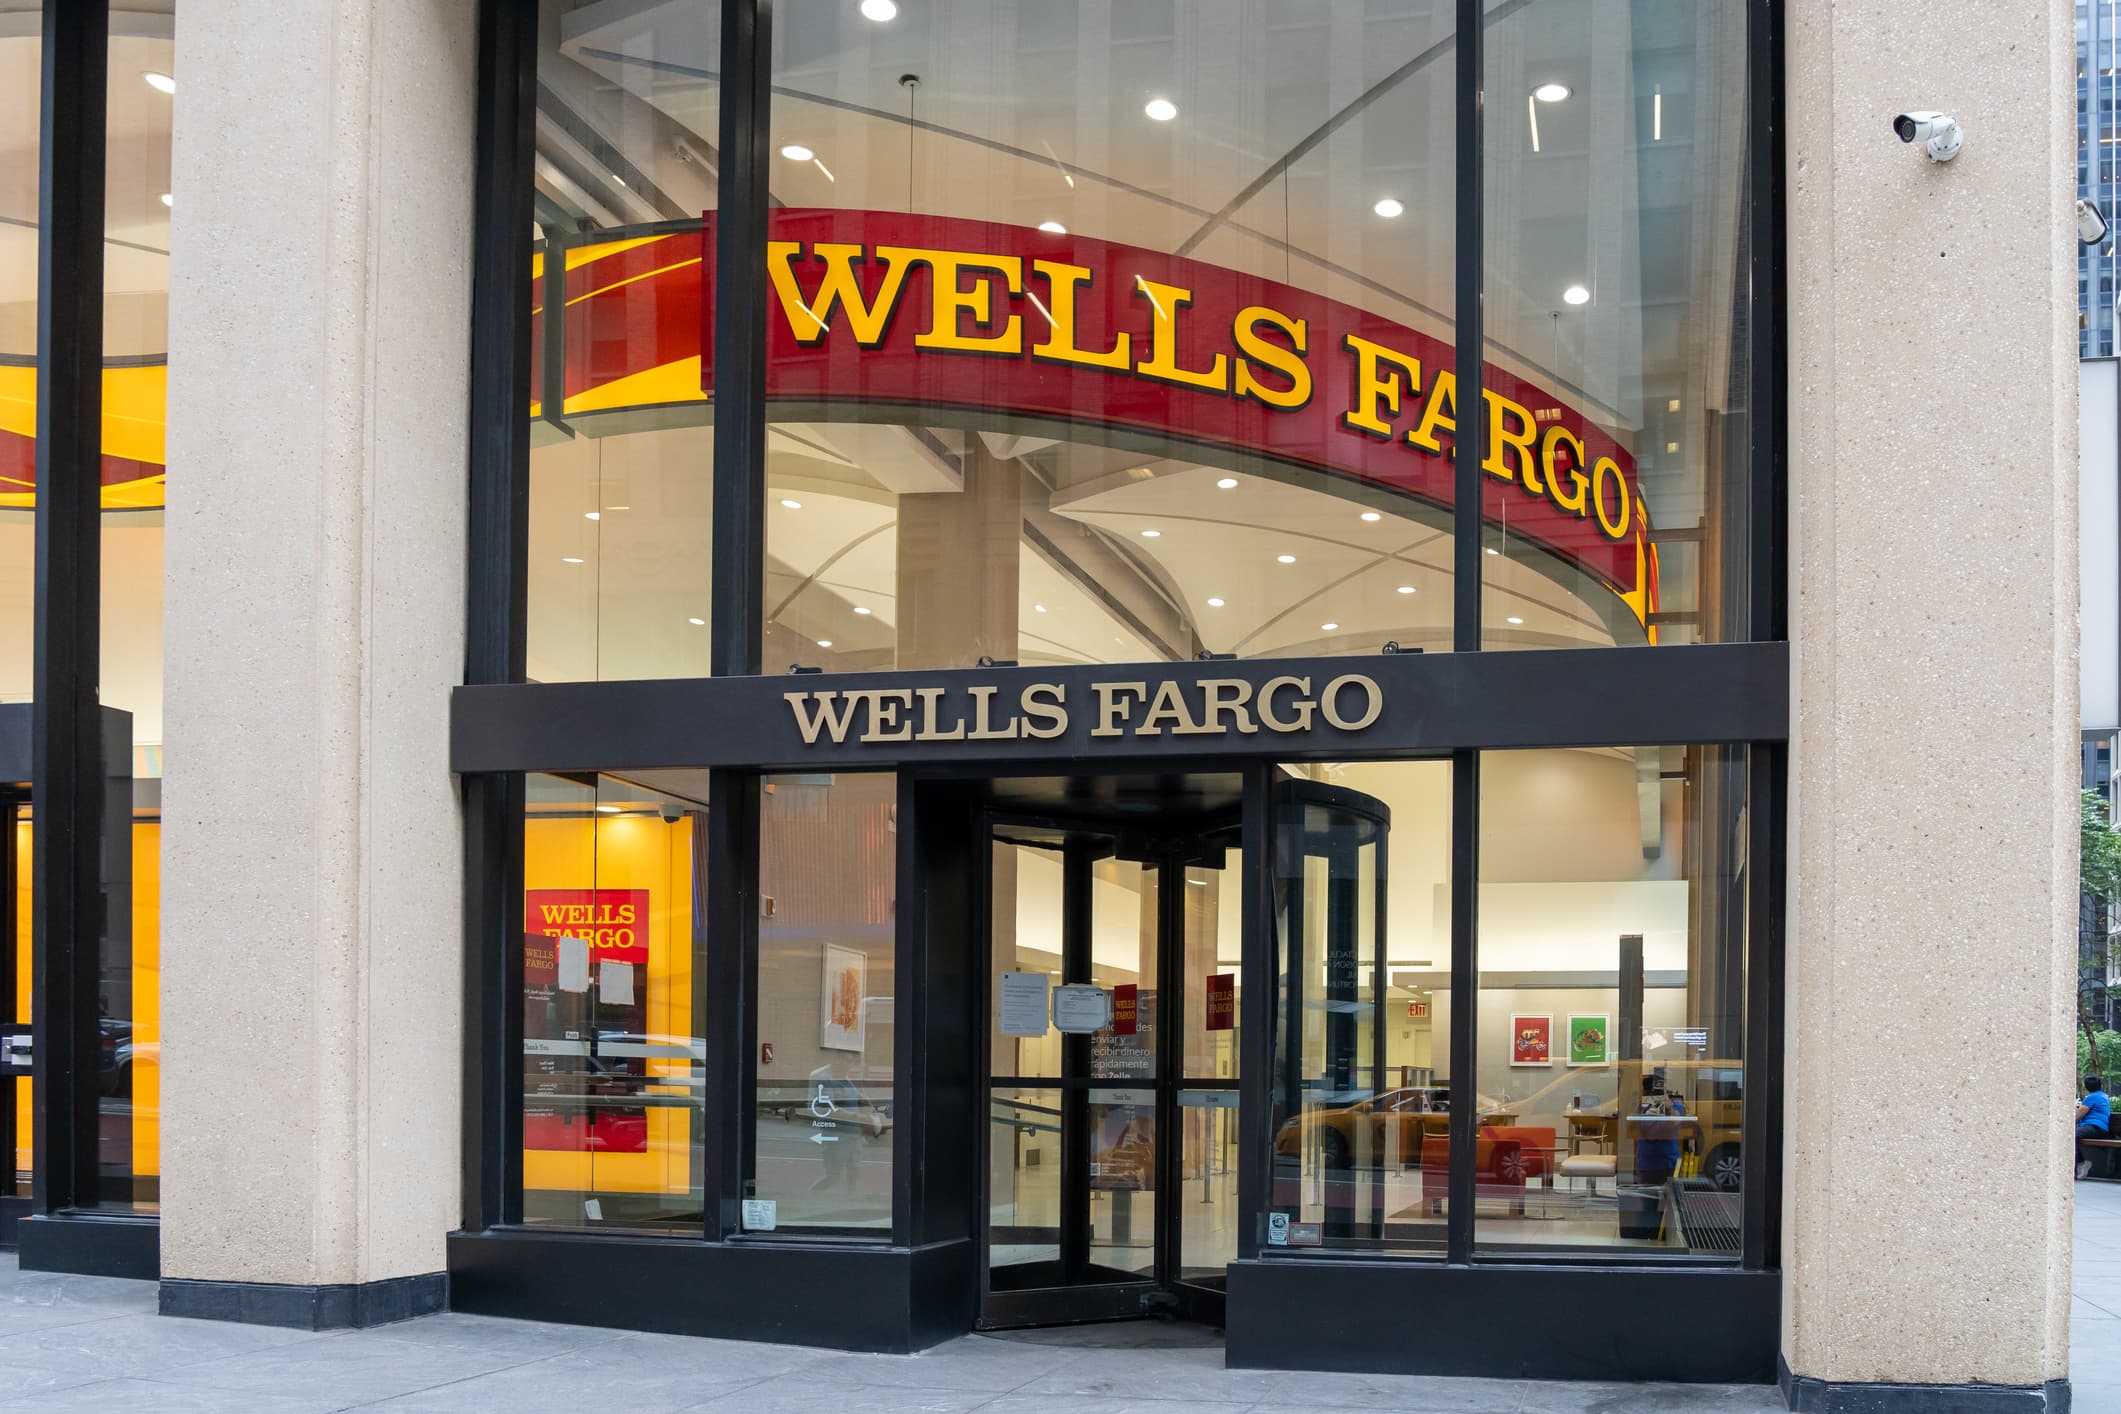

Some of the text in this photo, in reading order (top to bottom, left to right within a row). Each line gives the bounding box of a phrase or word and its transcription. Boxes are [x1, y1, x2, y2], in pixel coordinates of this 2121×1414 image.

[767, 241, 1630, 540] WELLS FARGO
[784, 673, 1384, 744] WELLS FARGO
[540, 904, 636, 925] WELLS
[525, 947, 554, 960] WELLS
[526, 959, 554, 970] FARGO
[1208, 990, 1233, 1001] WELLS
[1115, 1000, 1136, 1009] WELLS
[1208, 1002, 1233, 1014] FARGO
[1409, 1003, 1426, 1016] EXIT
[1115, 1010, 1136, 1020] FARGO
[1120, 1047, 1151, 1057] dinero
[812, 1120, 836, 1128] Access
